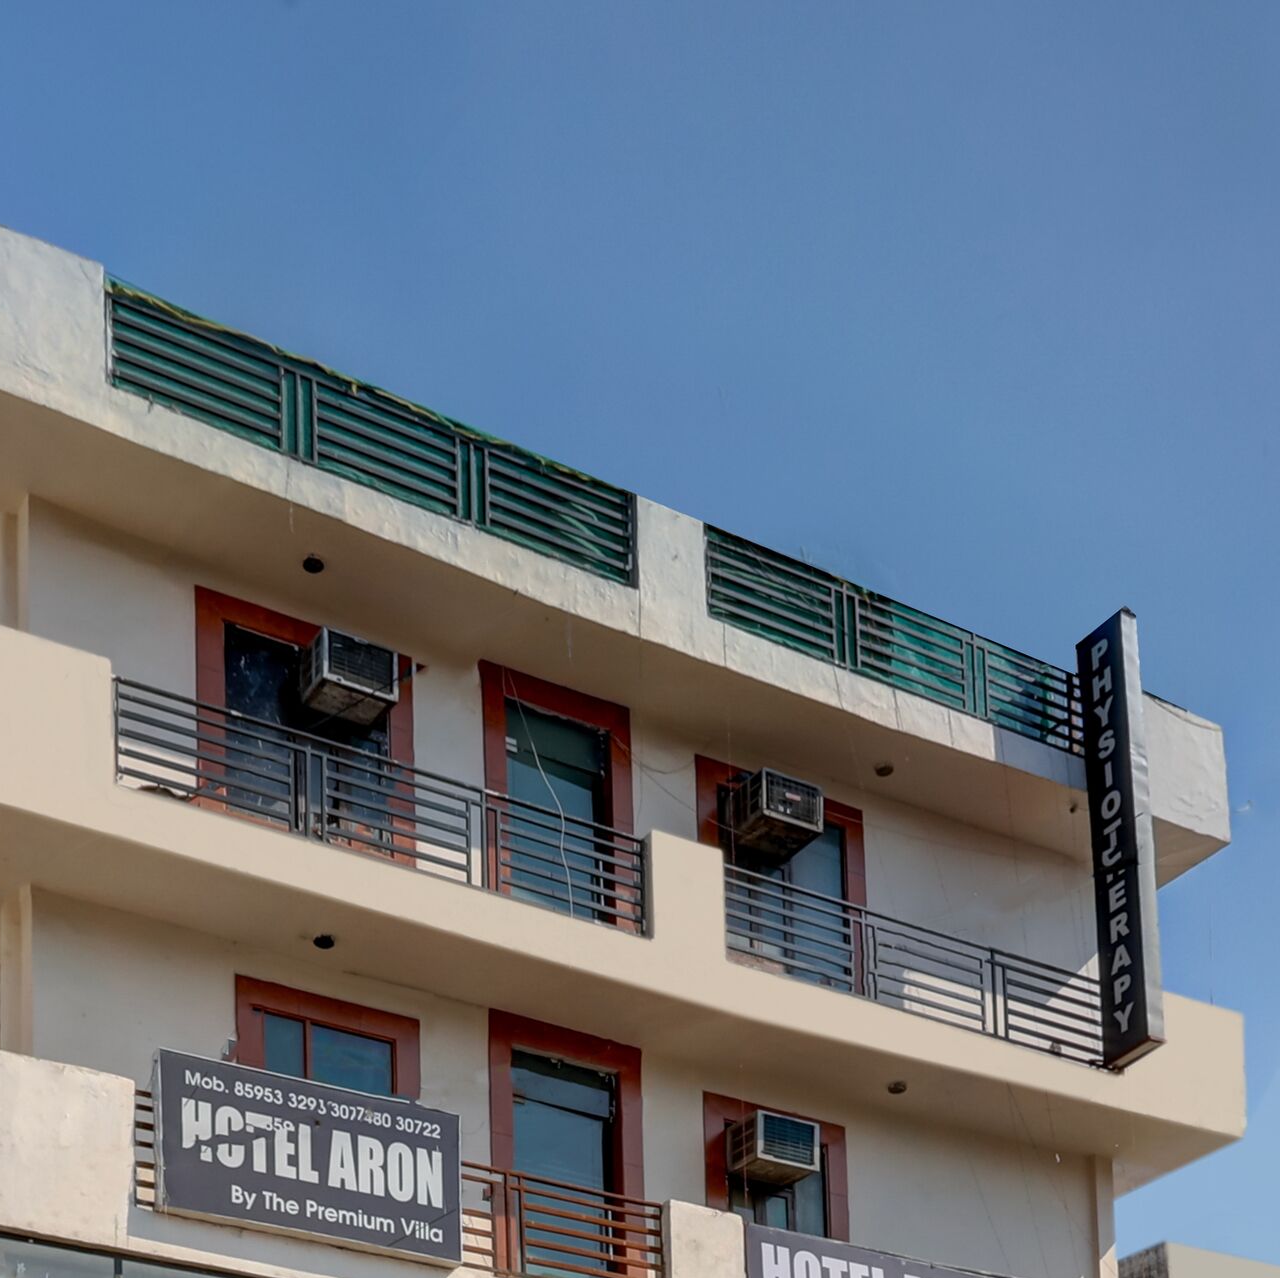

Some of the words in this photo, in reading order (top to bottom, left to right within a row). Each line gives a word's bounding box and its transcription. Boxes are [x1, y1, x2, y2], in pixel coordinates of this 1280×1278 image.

[184, 1069, 228, 1095] Mob.
[234, 1081, 283, 1105] 85953
[395, 1114, 442, 1139] 30722
[328, 1129, 444, 1209] ARON
[231, 1185, 257, 1210] By
[262, 1190, 300, 1215] The
[306, 1201, 395, 1235] Premium
[400, 1217, 443, 1244] Villa
